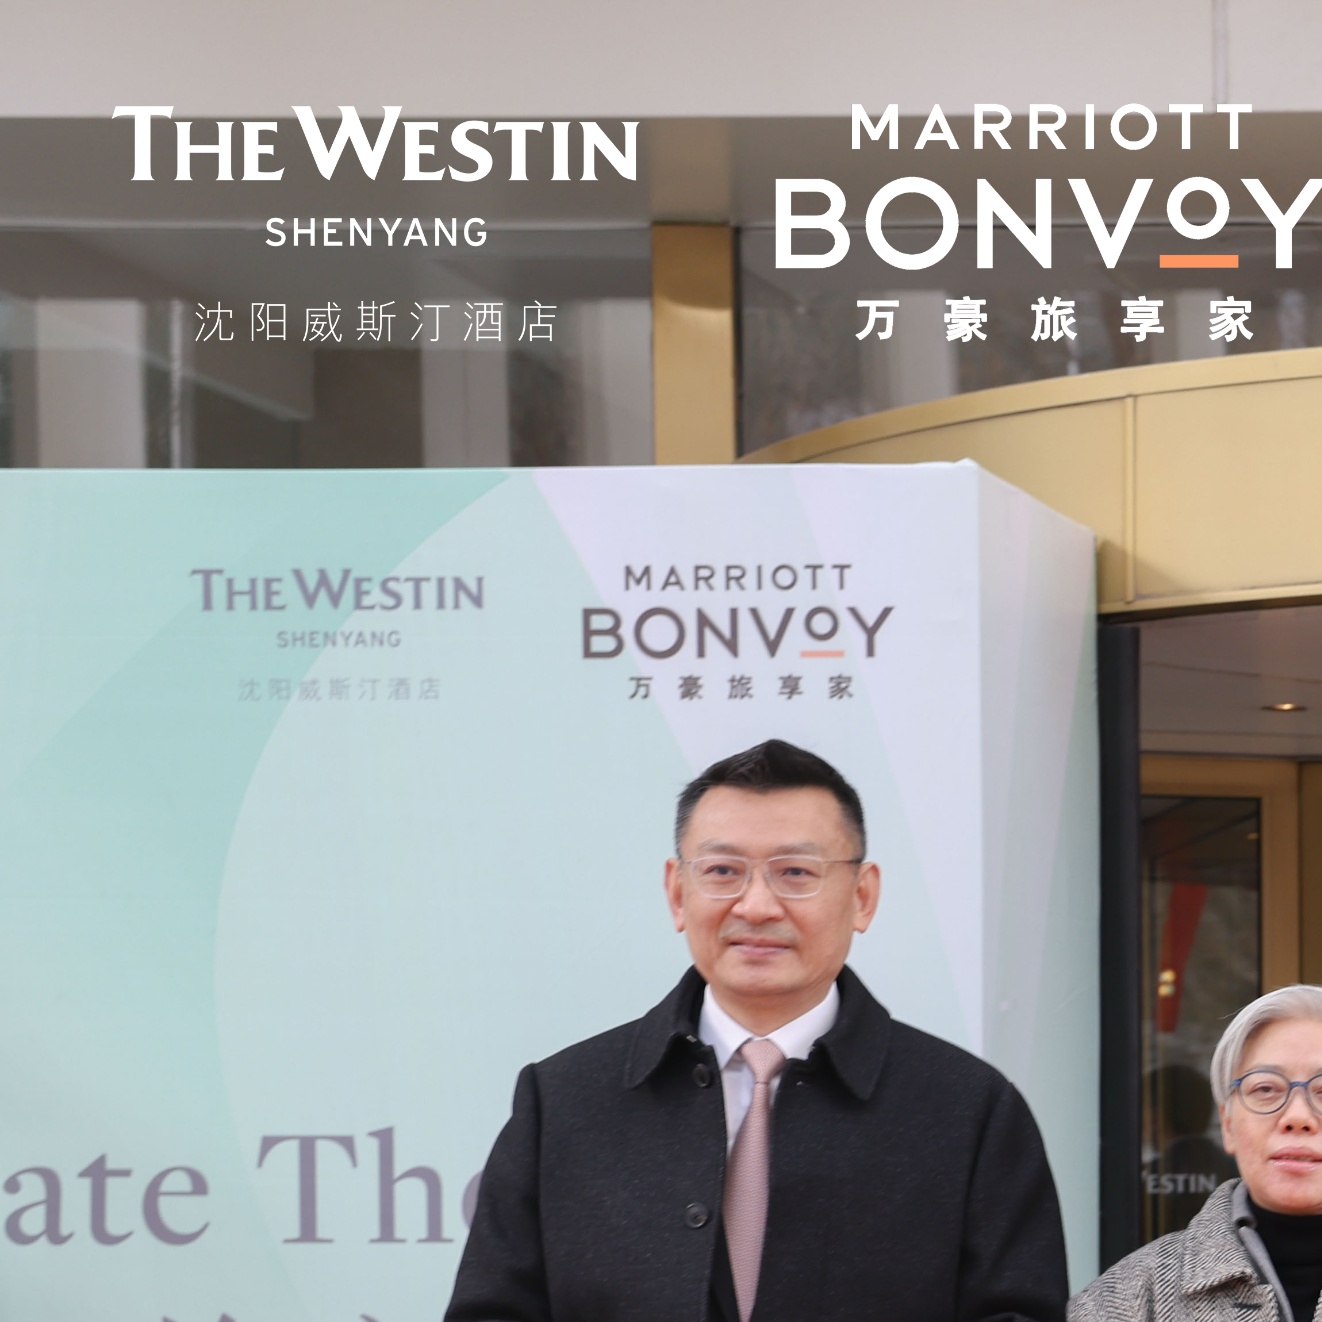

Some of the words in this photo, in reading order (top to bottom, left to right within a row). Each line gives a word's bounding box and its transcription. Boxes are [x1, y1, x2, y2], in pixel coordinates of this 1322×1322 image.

[189, 568, 286, 611] THE
[291, 567, 485, 611] WESTIN
[623, 563, 852, 592] MARRIOTT
[276, 629, 402, 649] SHENYANG
[581, 604, 896, 660] BONVOY
[237, 675, 441, 702] 沈阳威斯汀酒店
[627, 673, 855, 701] 万豪旅享家
[1141, 1168, 1216, 1194] ESTIN
